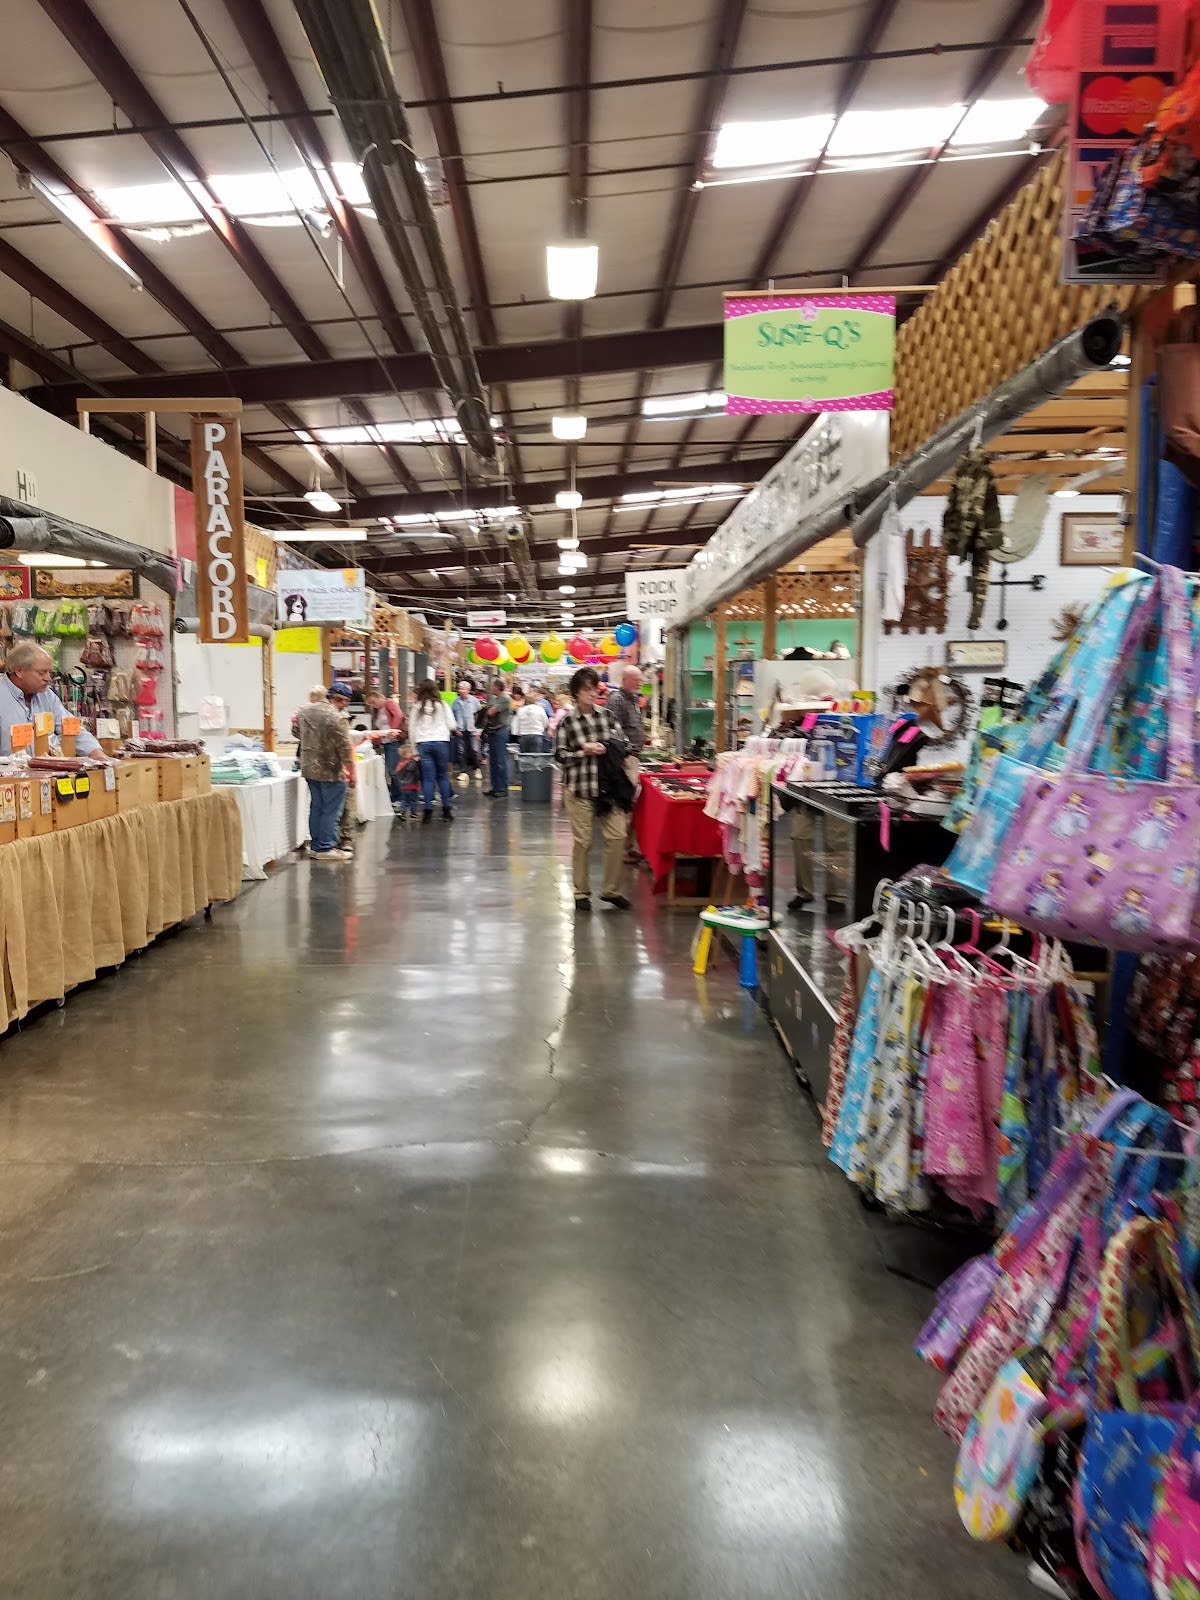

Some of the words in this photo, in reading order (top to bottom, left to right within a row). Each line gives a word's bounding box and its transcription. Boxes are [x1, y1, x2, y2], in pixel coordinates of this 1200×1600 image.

[1081, 96, 1158, 114] MasterCa
[203, 423, 238, 640] PARACORD
[638, 580, 677, 595] ROCK
[638, 599, 678, 614] SHOP
